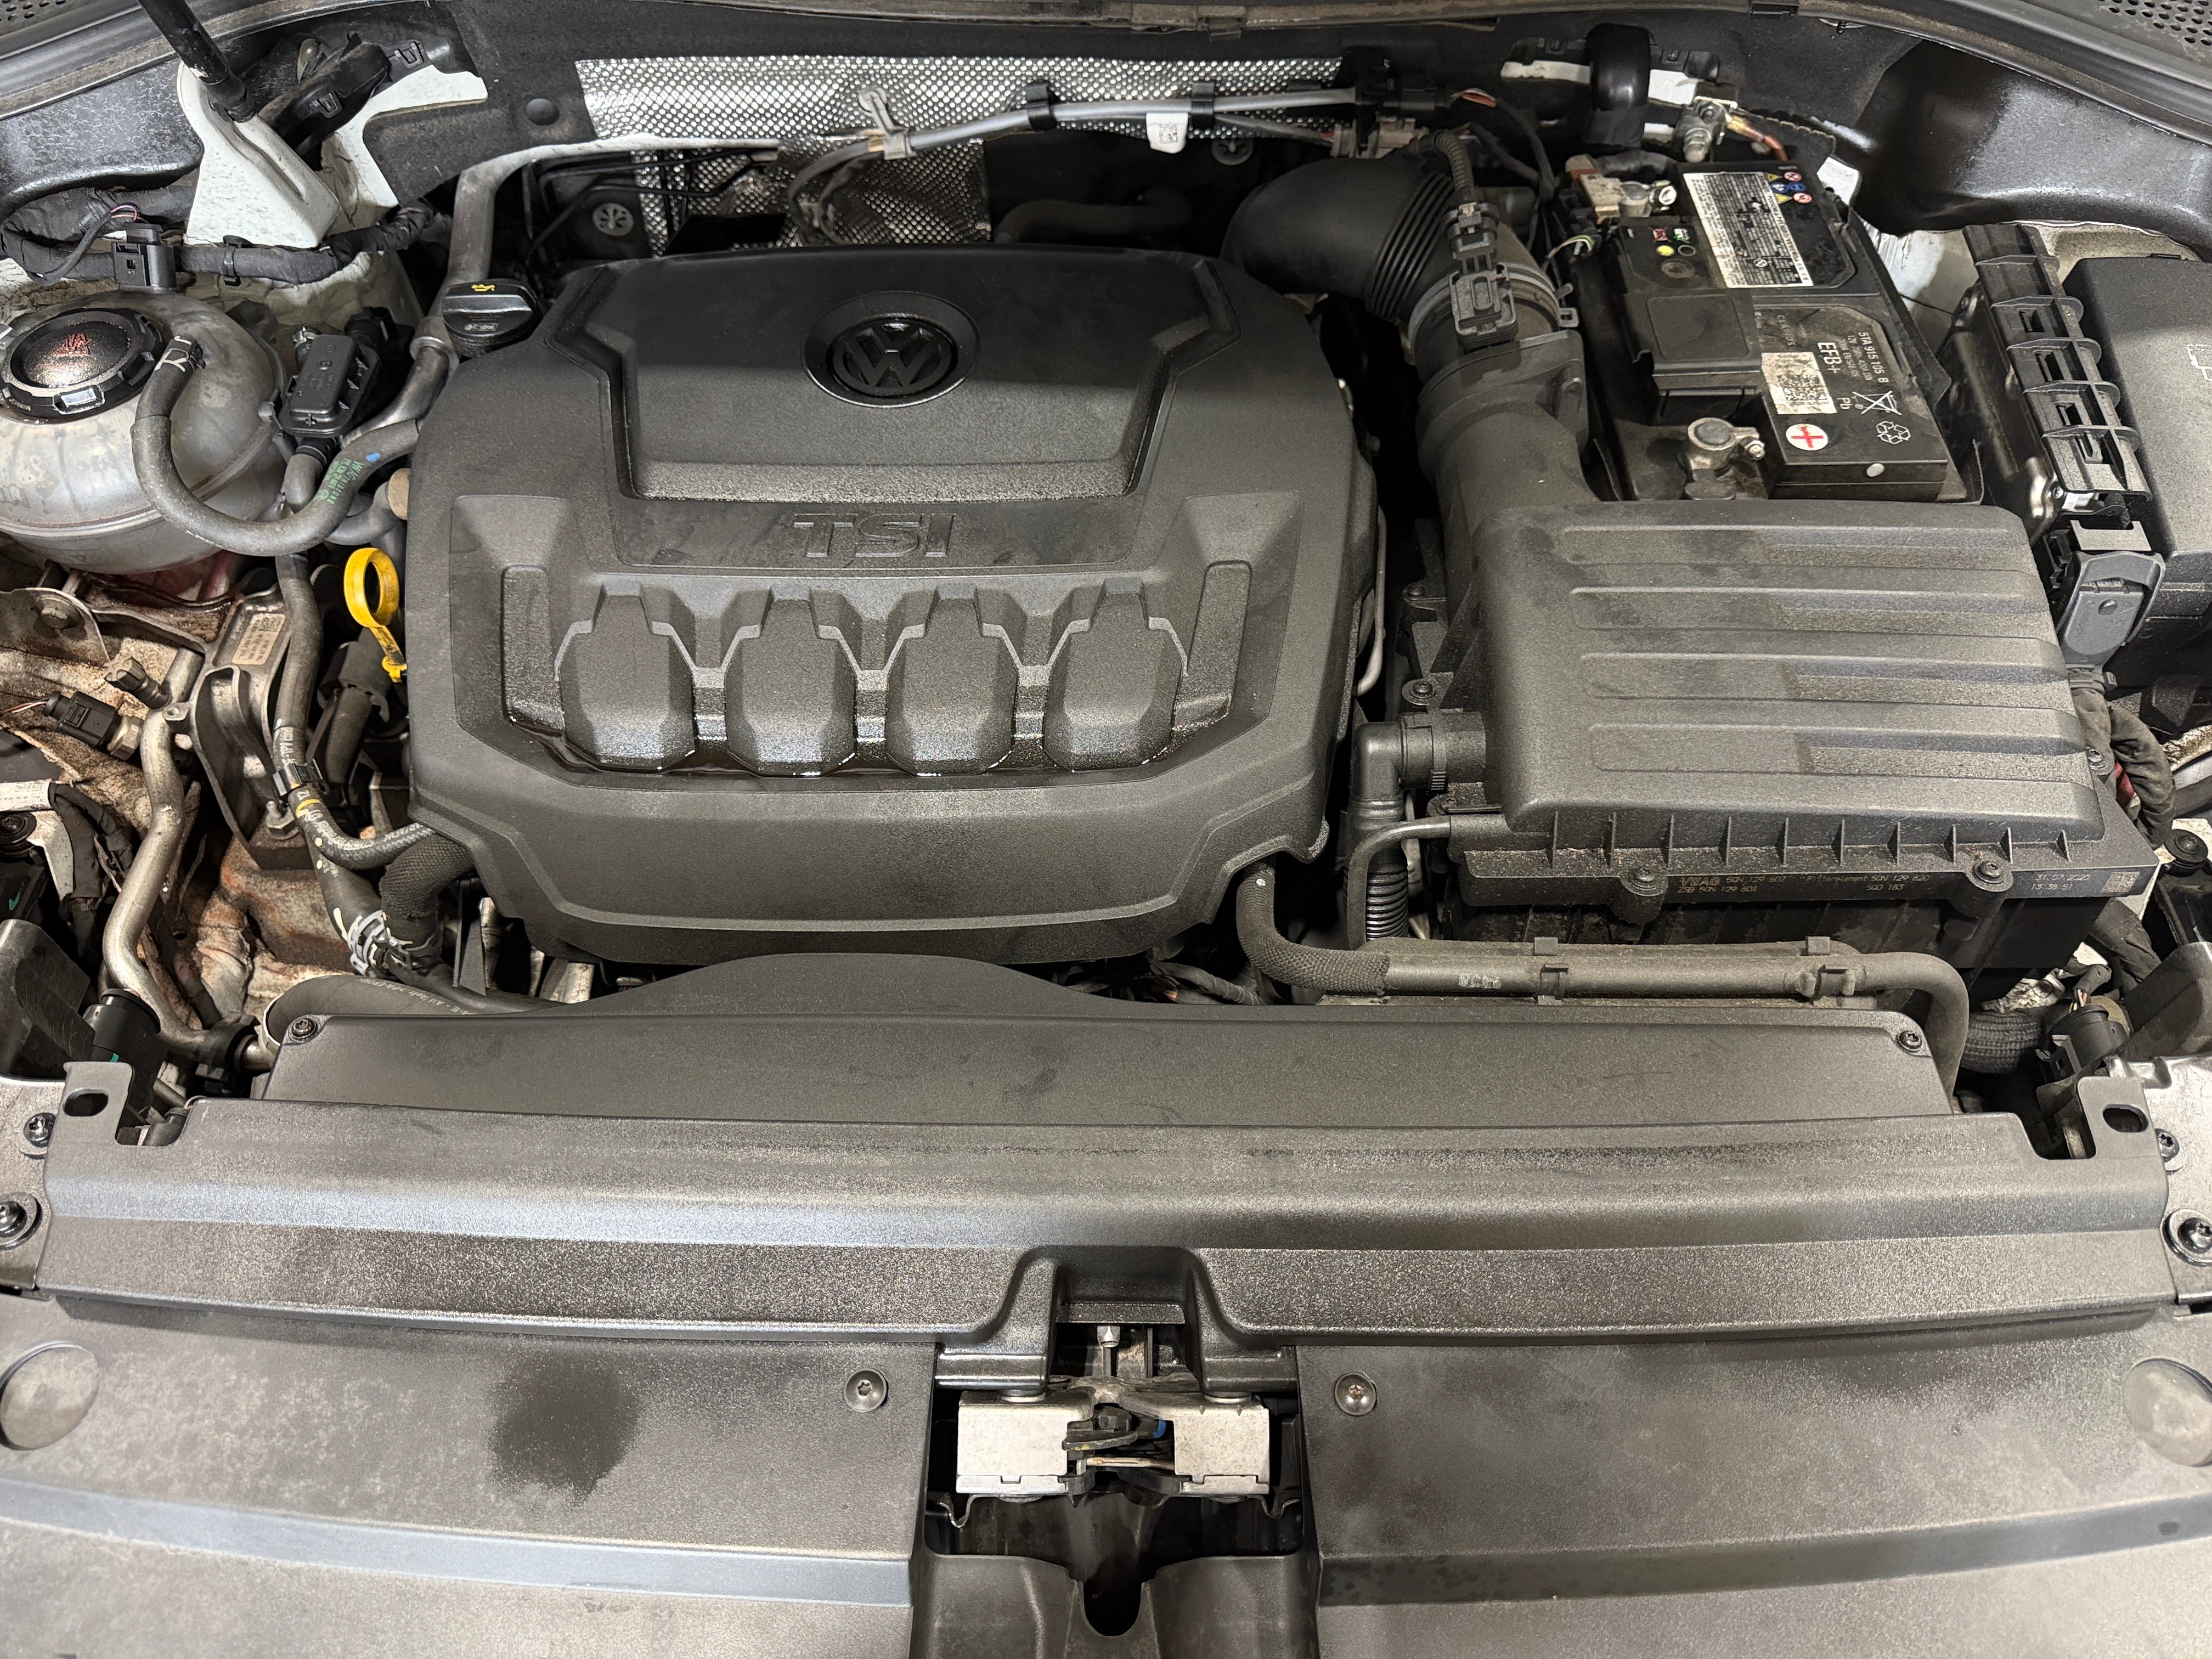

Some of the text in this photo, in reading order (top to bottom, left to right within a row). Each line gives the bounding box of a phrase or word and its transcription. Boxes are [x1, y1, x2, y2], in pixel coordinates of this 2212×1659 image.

[1858, 332, 1872, 345] 5TA
[1817, 342, 1843, 374] EFB+
[1864, 346, 1878, 359] 915
[1871, 362, 1885, 374] 105
[1837, 397, 1852, 410] Pb
[793, 513, 957, 558] TSI
[1680, 877, 1720, 886] VWAG
